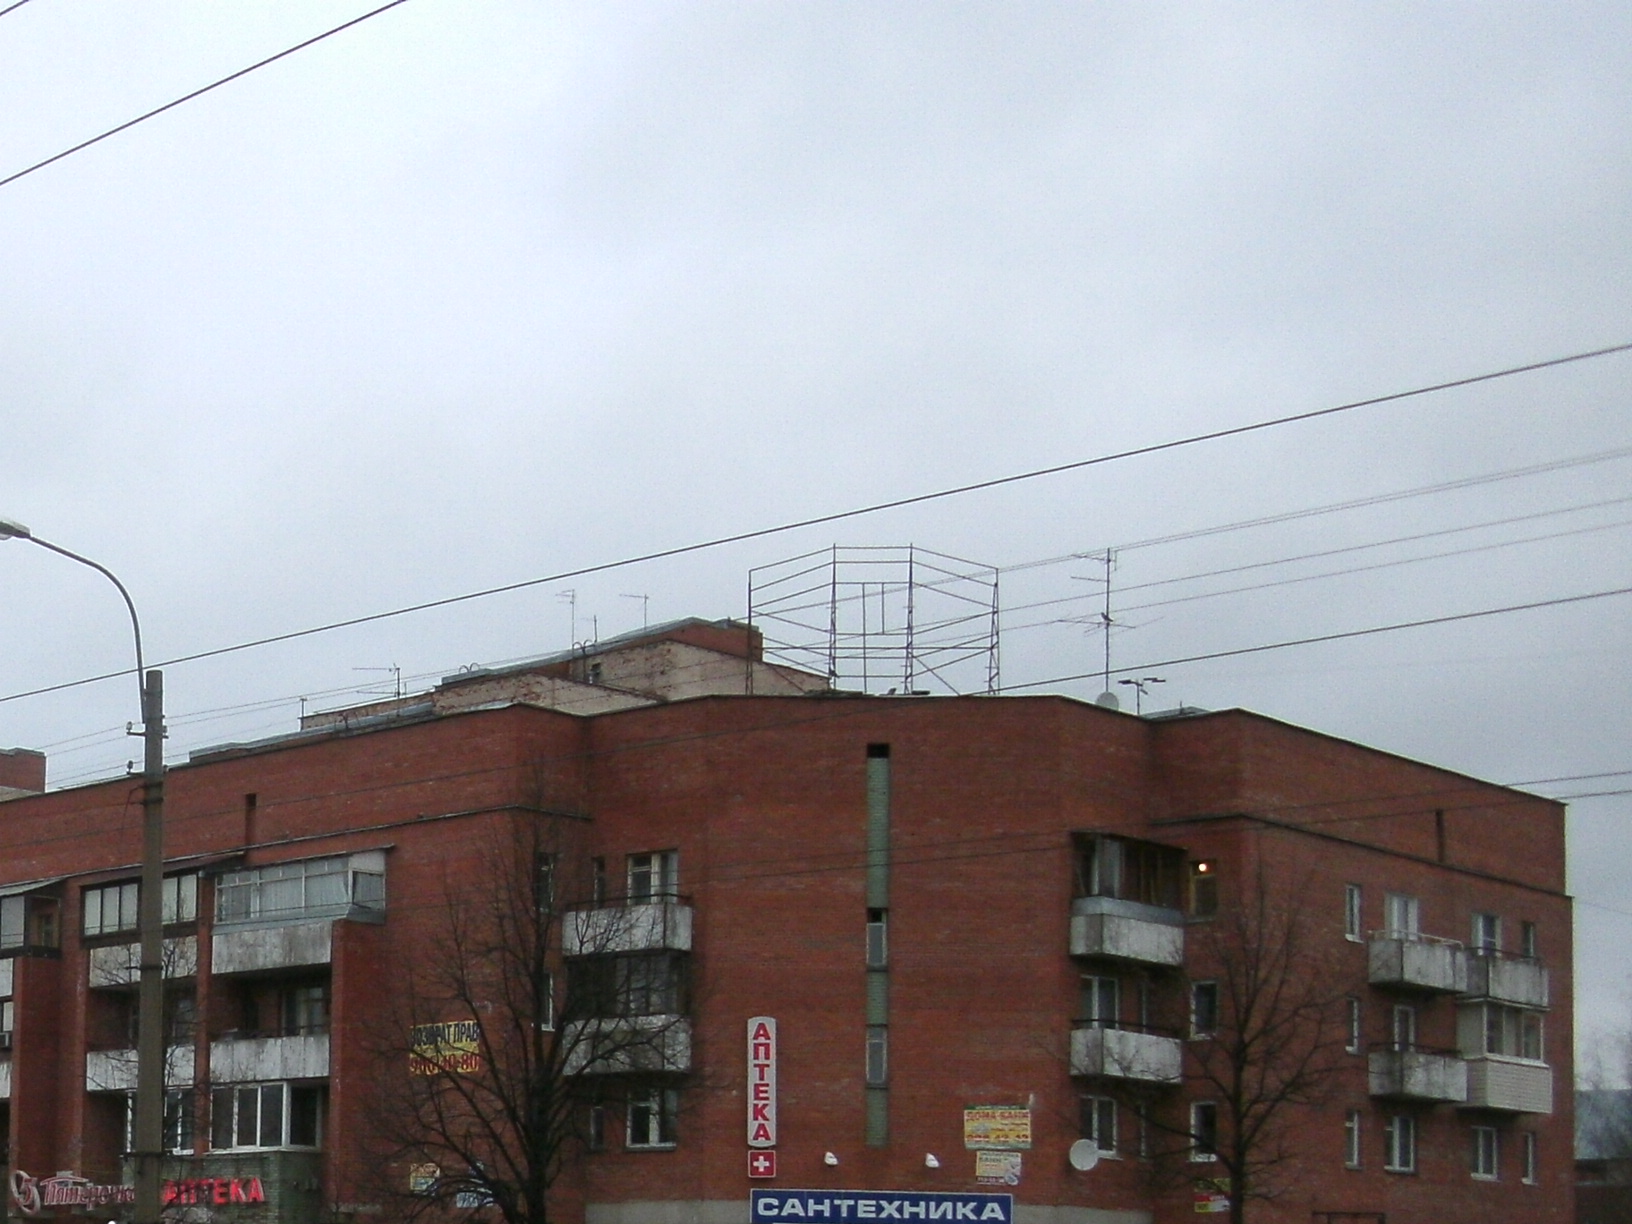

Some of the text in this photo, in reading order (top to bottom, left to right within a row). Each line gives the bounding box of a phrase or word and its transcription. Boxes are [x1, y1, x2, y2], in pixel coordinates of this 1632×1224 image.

[753, 1022, 771, 1141] АПТЕКА
[161, 1177, 265, 1204] АПТЕКА
[757, 1197, 1005, 1221] САНТЕХНИКА
